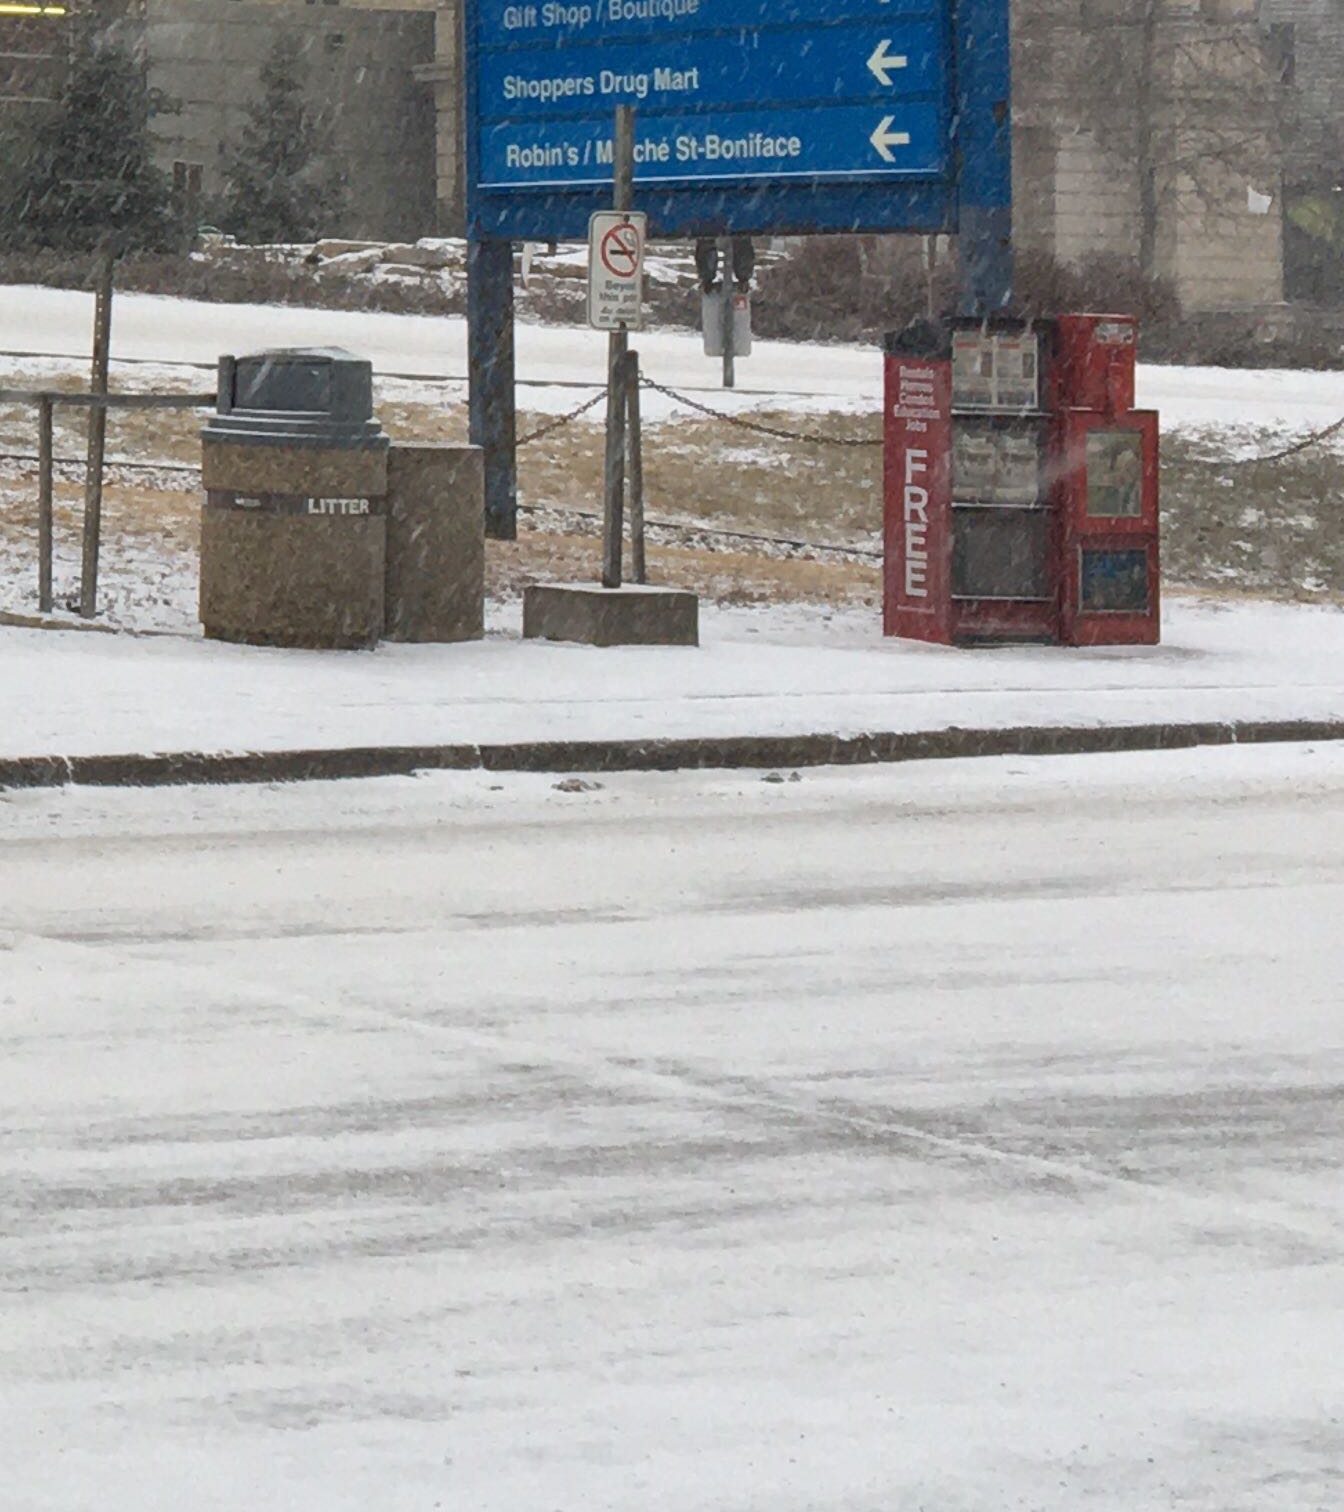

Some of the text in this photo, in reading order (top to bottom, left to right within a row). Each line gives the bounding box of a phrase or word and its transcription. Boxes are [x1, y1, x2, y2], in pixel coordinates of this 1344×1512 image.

[503, 4, 538, 31] Gift
[541, 1, 592, 29] Shop
[503, 66, 700, 103] Shoppers Drug Mart
[506, 141, 580, 168] Robin's
[595, 136, 670, 164] Mché
[675, 132, 802, 162] St-Boniface
[307, 498, 370, 515] LITTER
[903, 448, 929, 598] FREE
